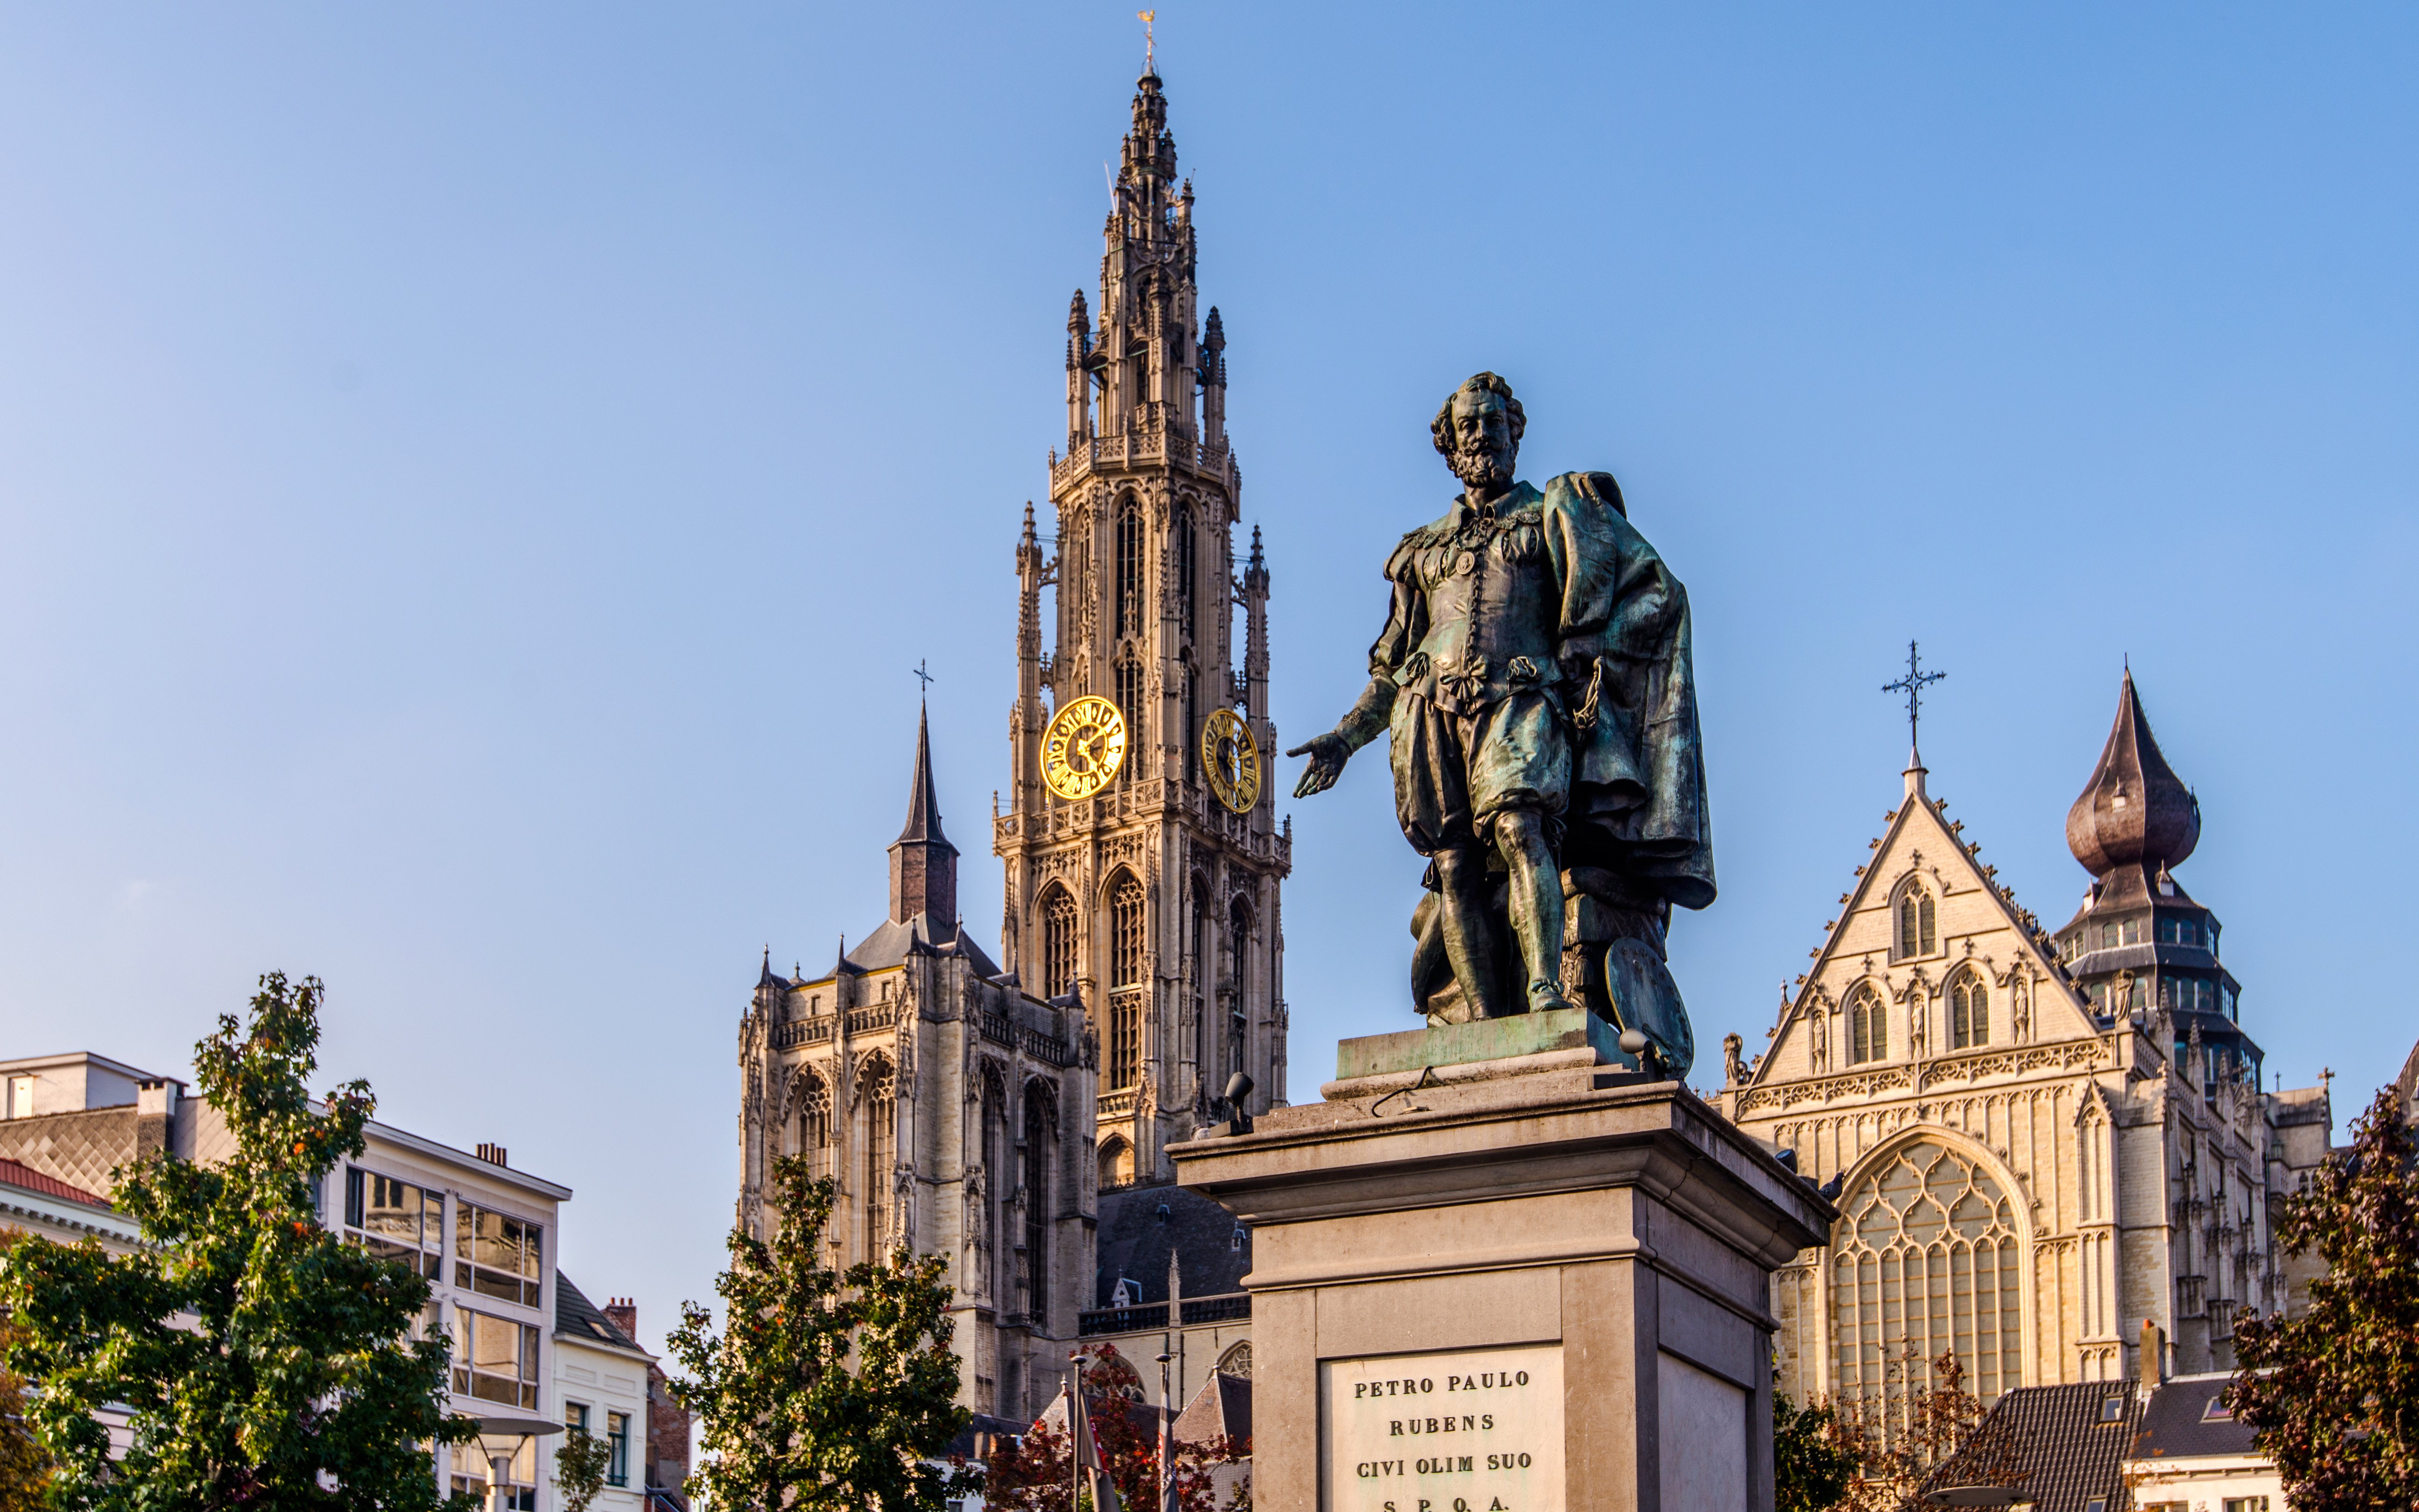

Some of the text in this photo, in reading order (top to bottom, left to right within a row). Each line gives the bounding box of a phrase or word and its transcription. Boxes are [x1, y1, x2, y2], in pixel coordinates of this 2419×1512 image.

[1354, 1371, 1529, 1399] PETRO PAULO
[1389, 1414, 1494, 1436] RUBENS
[1356, 1453, 1532, 1478] CIVI OLIM SUO
[1489, 1496, 1509, 1511] A.
